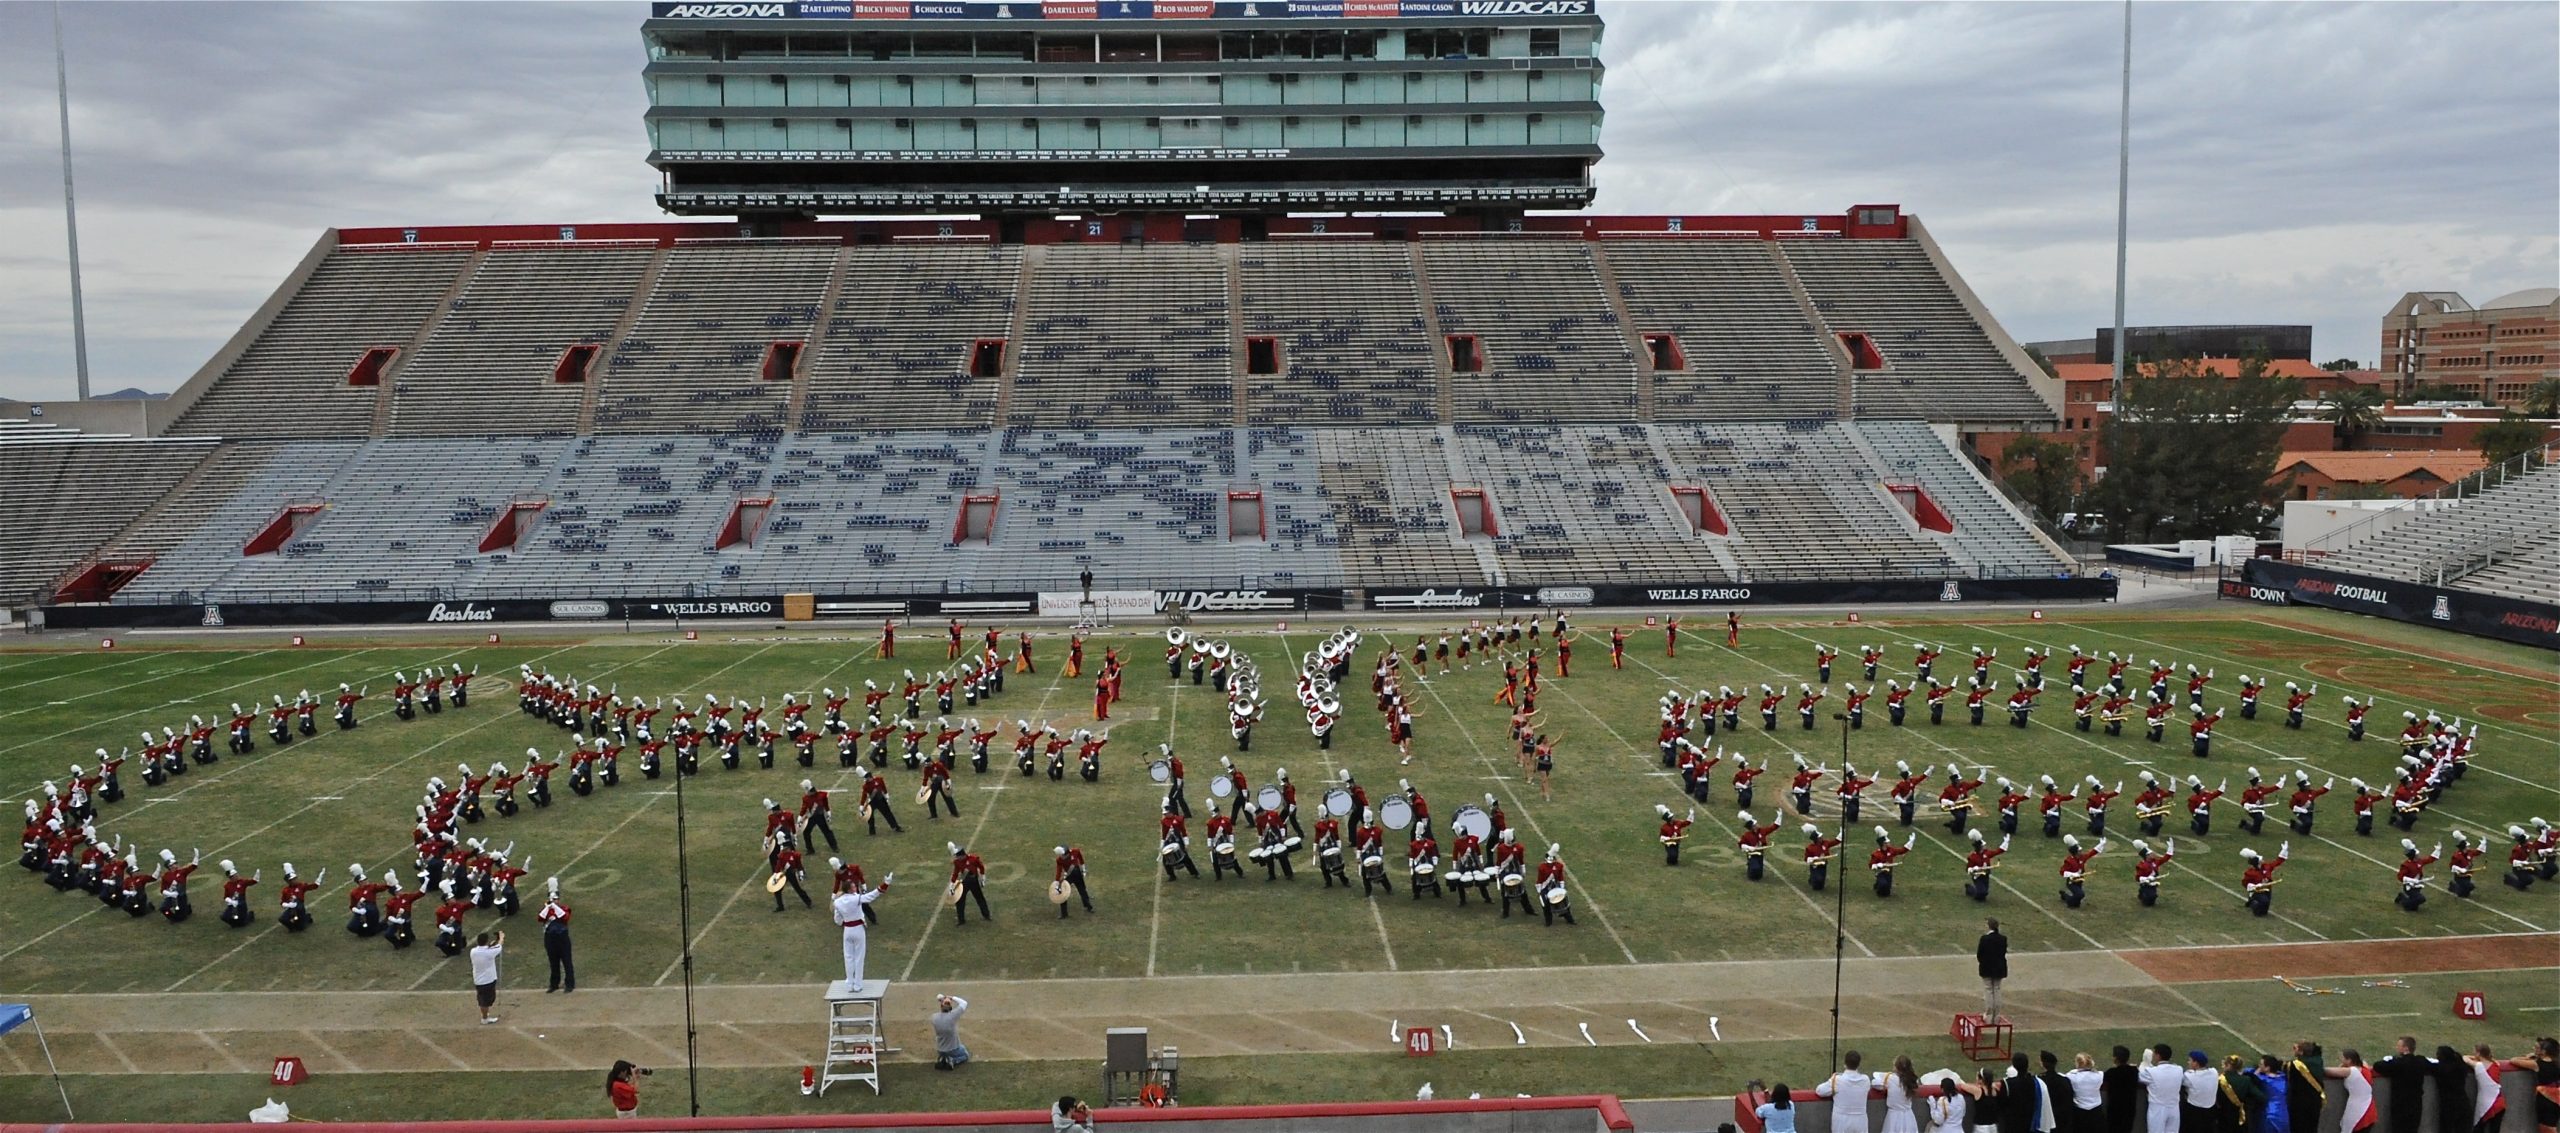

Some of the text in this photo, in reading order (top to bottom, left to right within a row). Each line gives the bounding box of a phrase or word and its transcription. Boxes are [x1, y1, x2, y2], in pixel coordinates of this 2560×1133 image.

[665, 4, 785, 18] ARIZONA
[801, 5, 809, 13] 22
[864, 6, 883, 14] RICKY
[885, 6, 909, 14] HUNLEY
[921, 6, 943, 14] CHUCK
[945, 6, 963, 14] CECIL
[1048, 6, 1076, 14] DARRYLL
[1077, 6, 1096, 14] LEWIS
[1461, 2, 1588, 15] WILDCATS
[1090, 226, 1100, 235] 21
[1313, 224, 1326, 234] 22
[1669, 222, 1681, 232] 24
[406, 234, 416, 243] 17
[562, 232, 573, 240] 18
[32, 406, 42, 416] 16
[1557, 591, 1591, 599] CASINOS
[1648, 589, 1750, 600] WELLS FARGO
[2250, 587, 2286, 602] DOWN
[2295, 578, 2388, 604] ARIZONA FOOTBALL
[664, 602, 771, 613] WELLS FARGO
[1041, 599, 1077, 609] UNIVERSITY
[1118, 598, 1137, 608] BAND
[1138, 597, 1152, 607] DAY
[427, 603, 495, 621] Bashas'
[2501, 612, 2557, 633] ARIZONA
[2463, 997, 2483, 1016] 20
[1411, 1032, 1428, 1052] 40
[274, 1061, 293, 1081] 40
